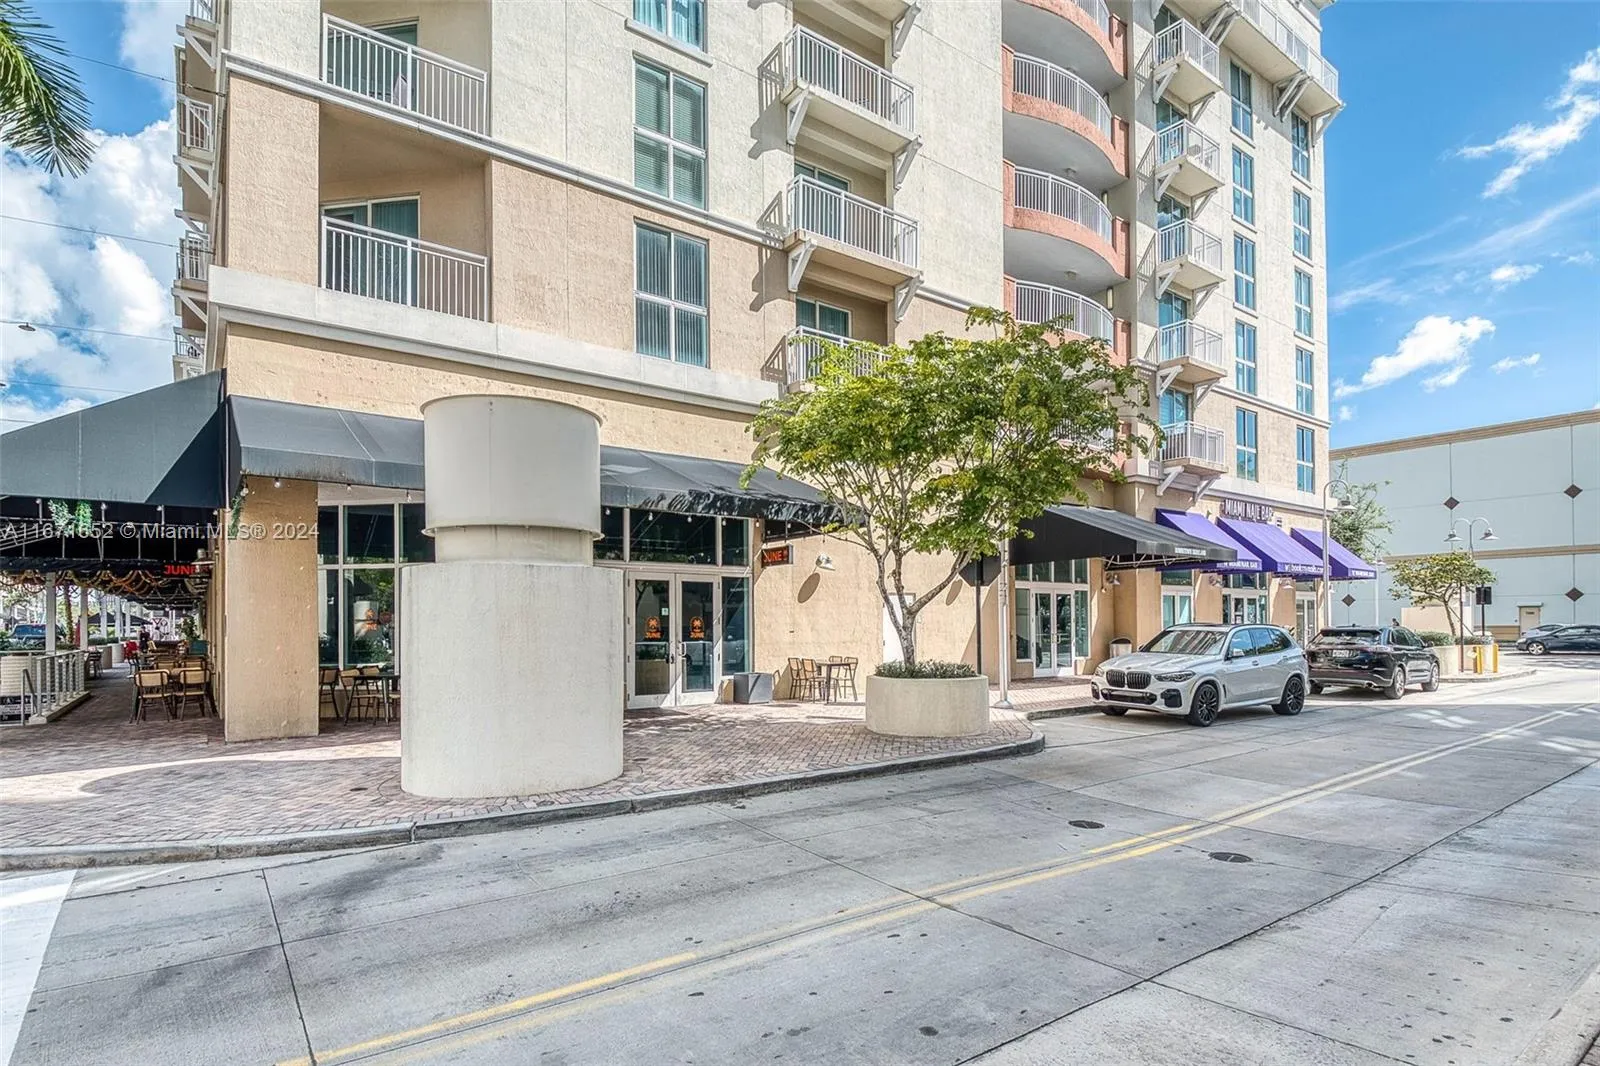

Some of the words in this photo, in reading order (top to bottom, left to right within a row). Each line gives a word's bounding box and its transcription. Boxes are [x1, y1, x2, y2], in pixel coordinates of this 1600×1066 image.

[1225, 498, 1245, 517] MIAMI
[1246, 502, 1260, 520] NAIL
[1261, 505, 1272, 521] BAR
[764, 550, 782, 562] JUNE
